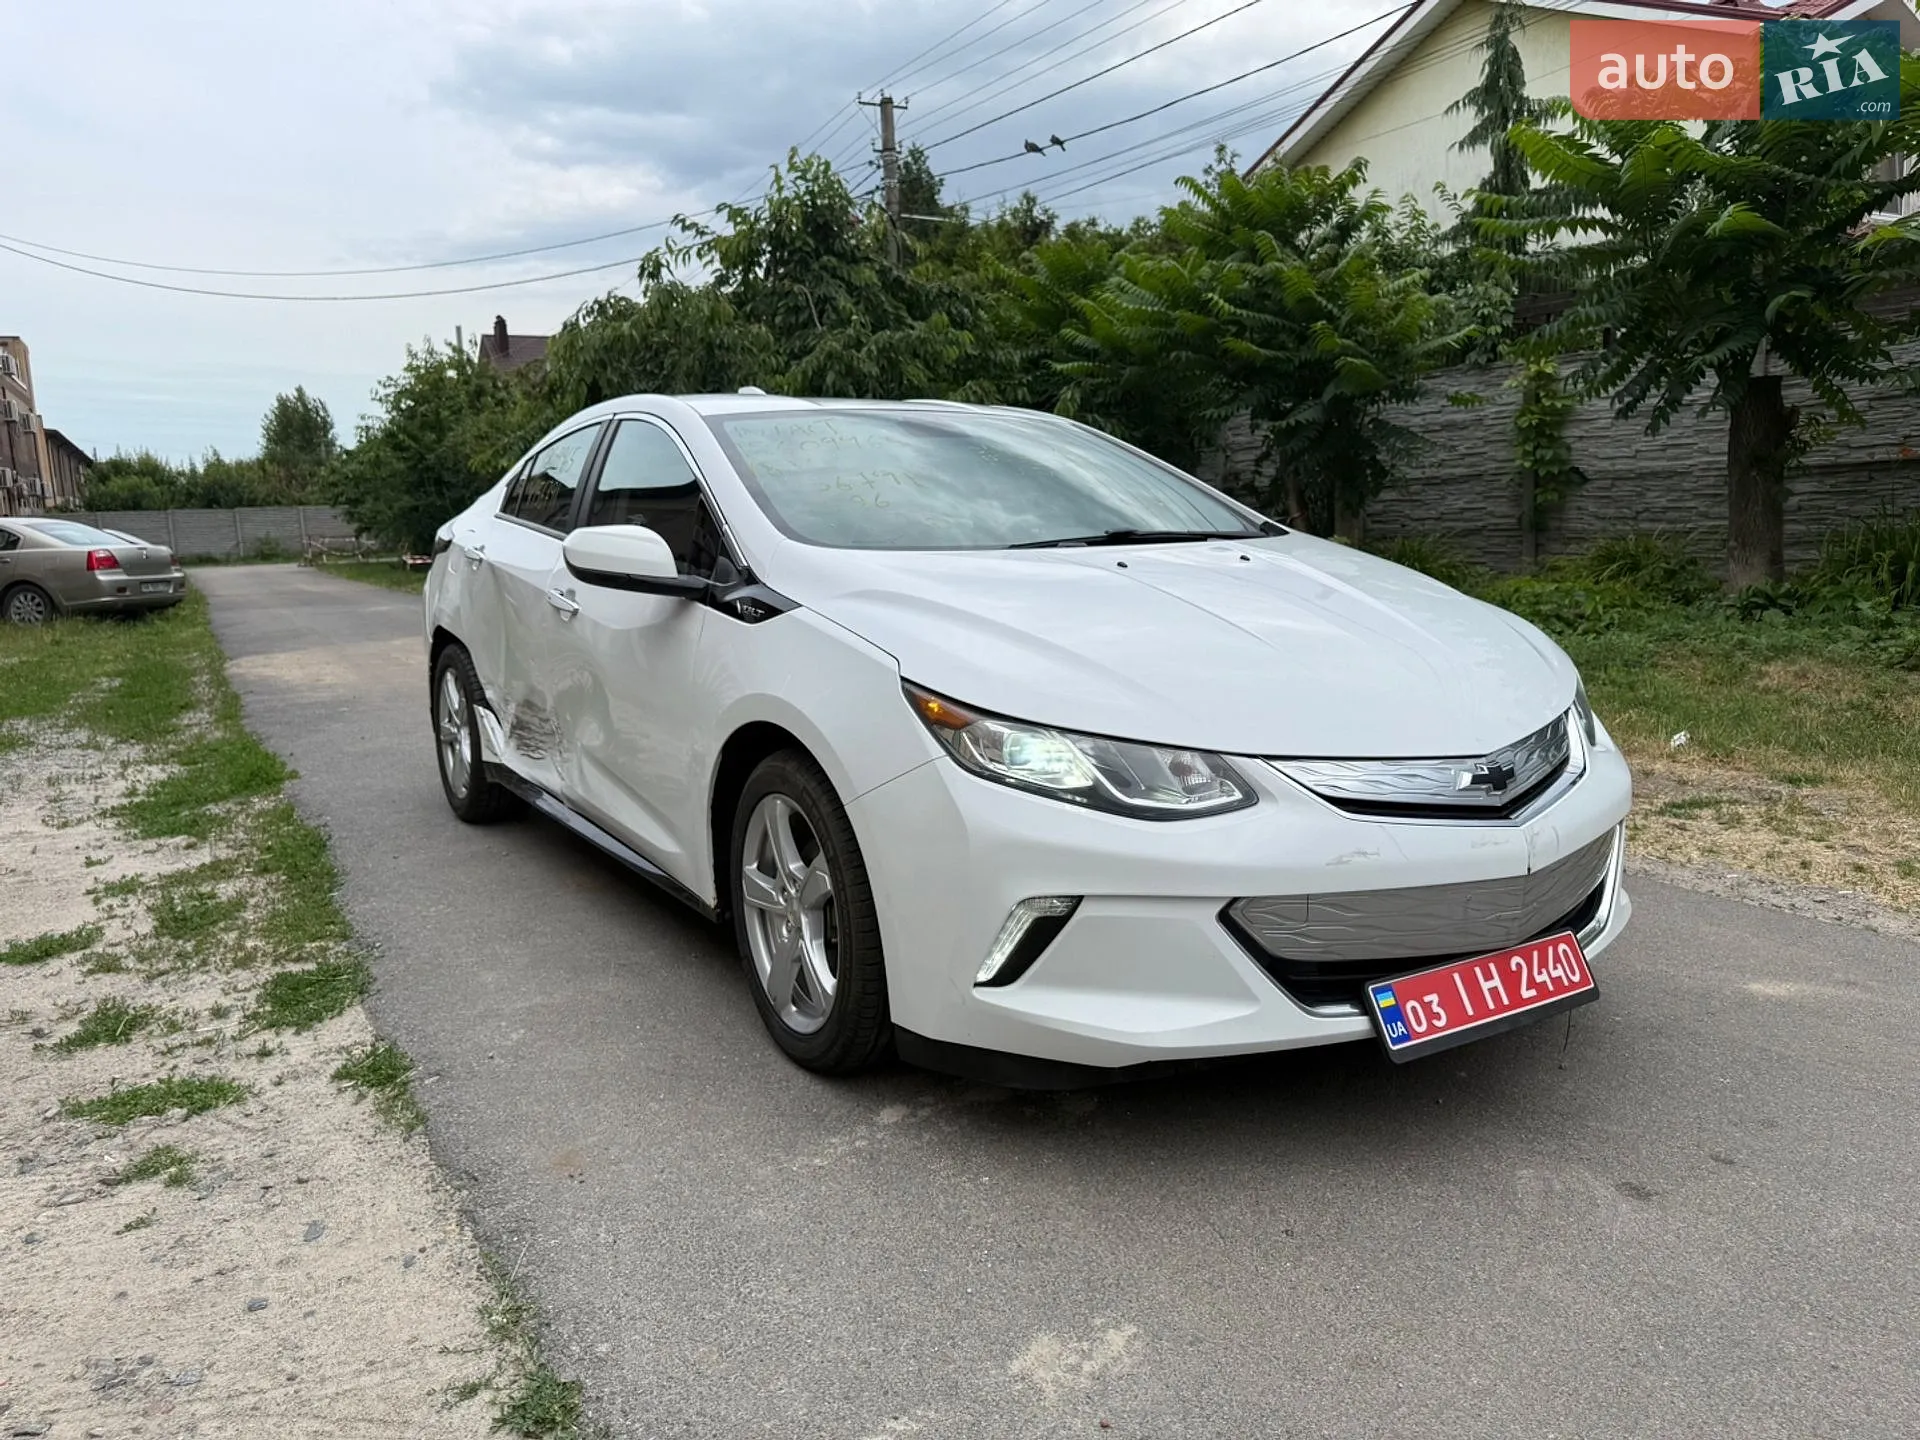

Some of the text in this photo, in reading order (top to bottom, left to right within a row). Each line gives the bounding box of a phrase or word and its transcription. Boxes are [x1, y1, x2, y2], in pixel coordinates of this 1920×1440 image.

[1405, 993, 1448, 1033] 03
[1510, 942, 1581, 999] 2440
[1387, 1021, 1408, 1038] UA
